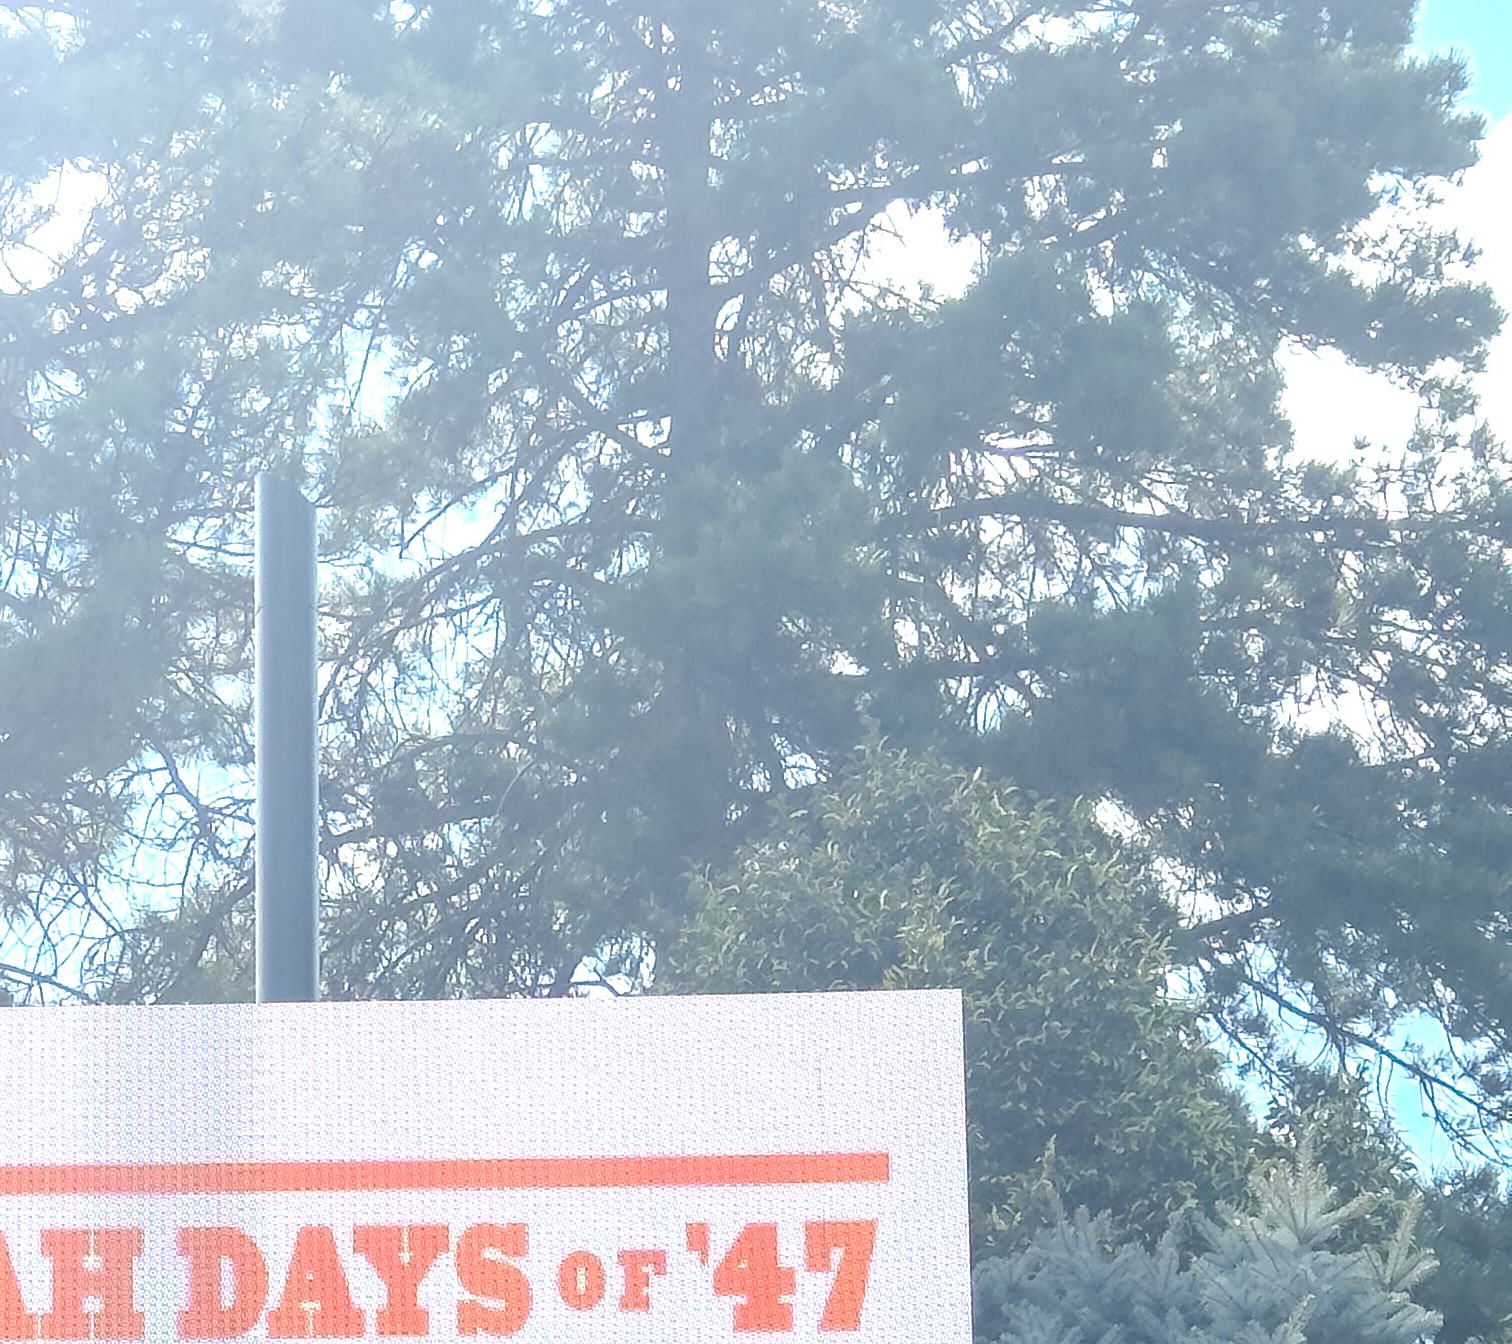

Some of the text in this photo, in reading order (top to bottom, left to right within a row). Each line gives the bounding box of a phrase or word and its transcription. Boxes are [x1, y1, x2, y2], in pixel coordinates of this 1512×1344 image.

[177, 1223, 532, 1340] DAYS
[557, 1248, 667, 1312] OF
[686, 1220, 879, 1333] '47
